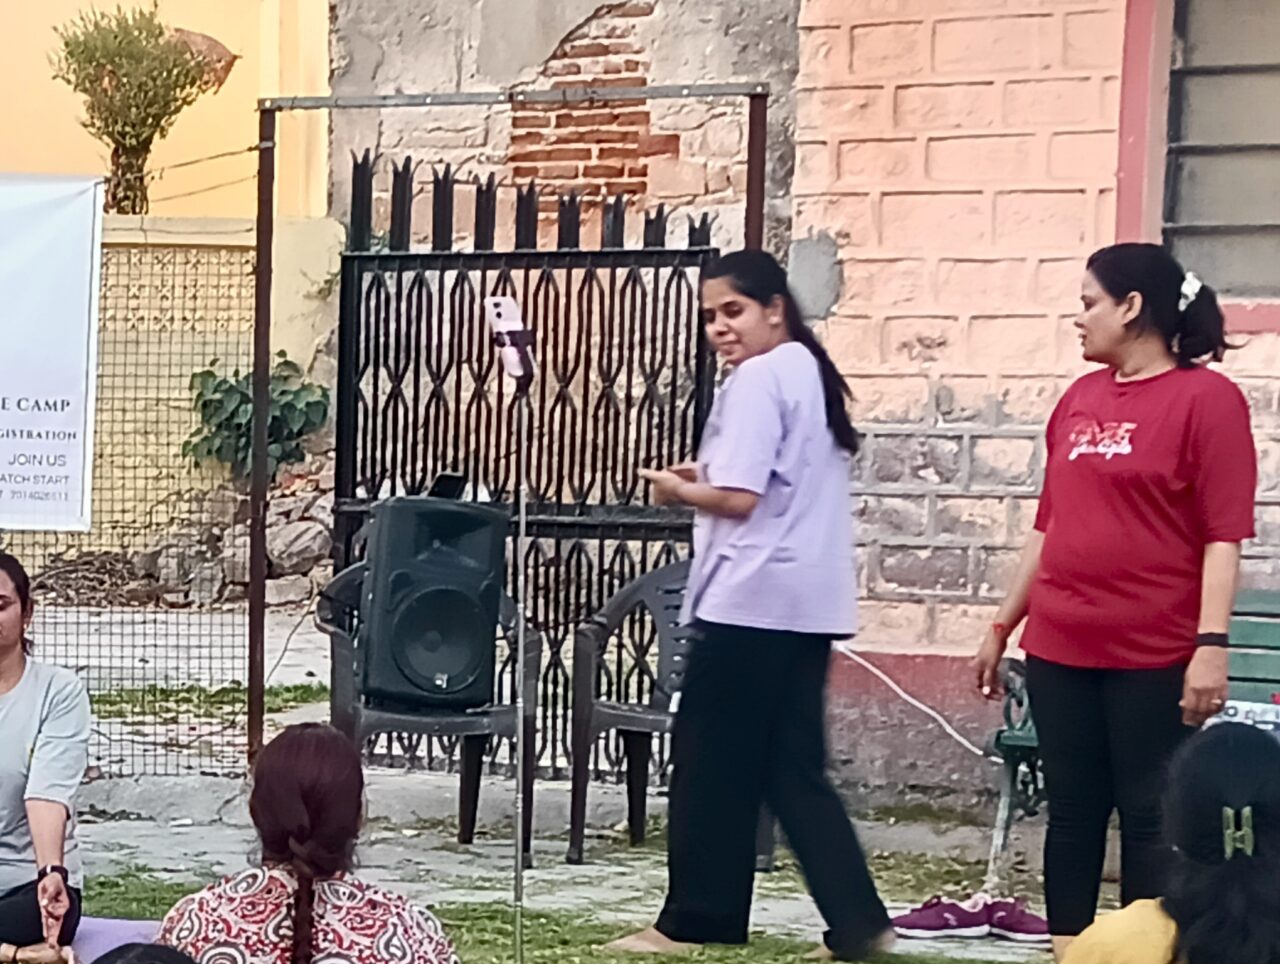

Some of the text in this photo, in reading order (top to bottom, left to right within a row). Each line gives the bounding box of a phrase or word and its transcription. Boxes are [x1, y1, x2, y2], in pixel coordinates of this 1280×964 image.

[16, 397, 71, 412] CAMP
[8, 453, 67, 467] JOIN US
[32, 475, 70, 485] START
